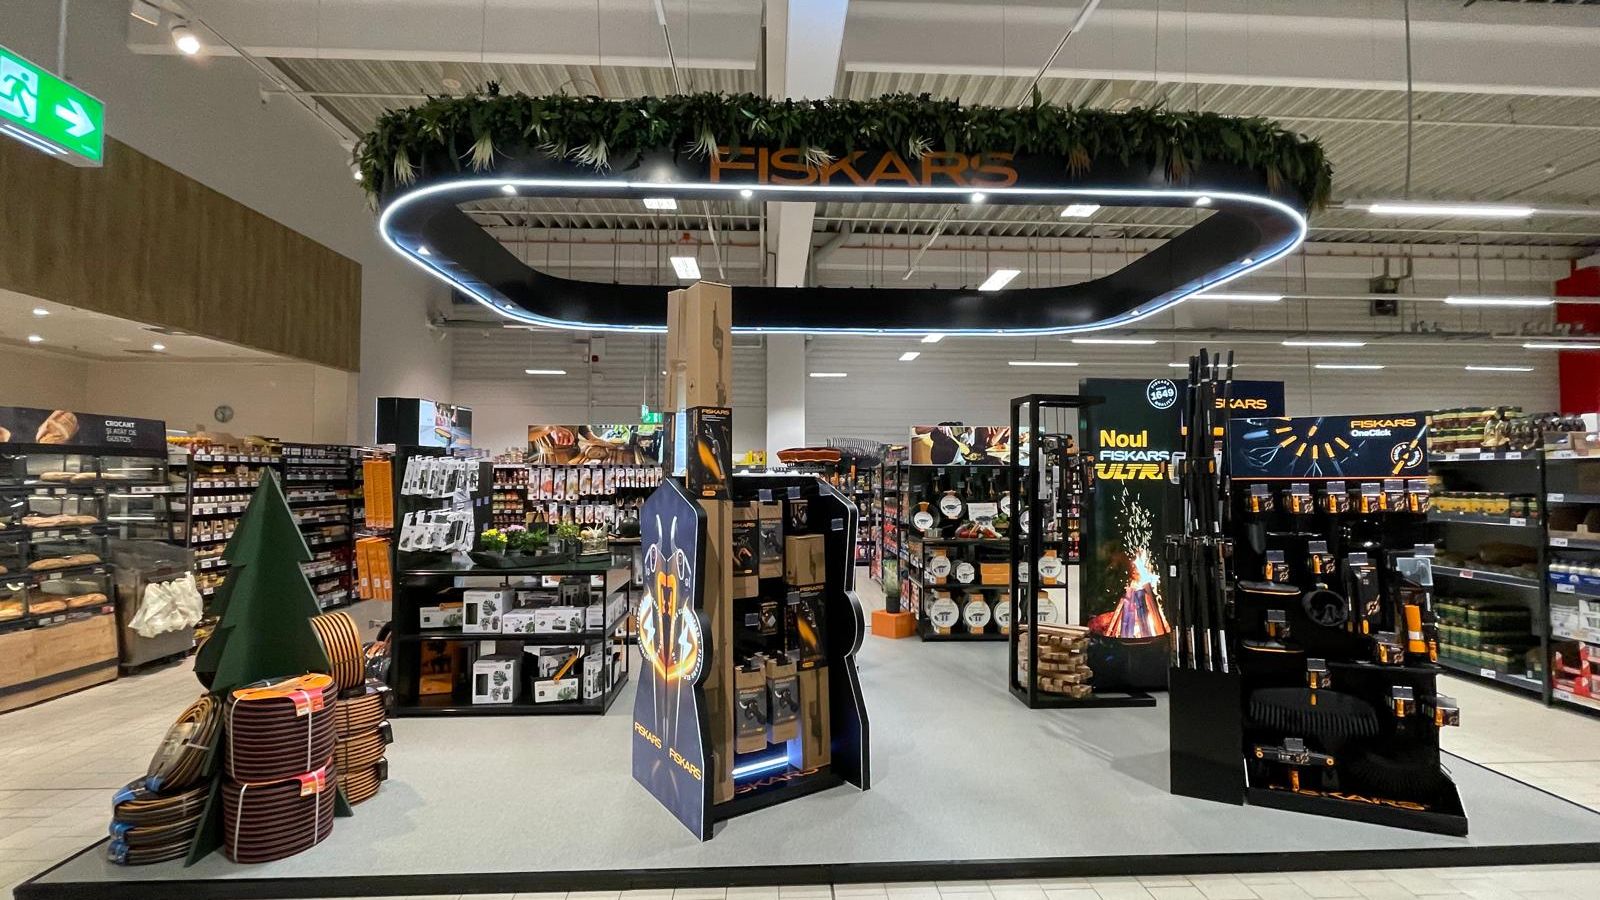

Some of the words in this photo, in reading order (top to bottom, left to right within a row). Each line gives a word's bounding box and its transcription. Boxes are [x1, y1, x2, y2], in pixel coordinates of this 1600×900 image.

[709, 147, 1018, 187] FISKARS
[1150, 388, 1175, 401] 1649
[1215, 398, 1268, 410] SKARS
[1350, 418, 1417, 429] FISKARS
[1100, 429, 1148, 448] Noul
[1350, 428, 1392, 437] OneClick
[1100, 450, 1170, 461] FISKARS
[634, 721, 662, 749] FISKARS
[669, 747, 702, 781] FISKARS
